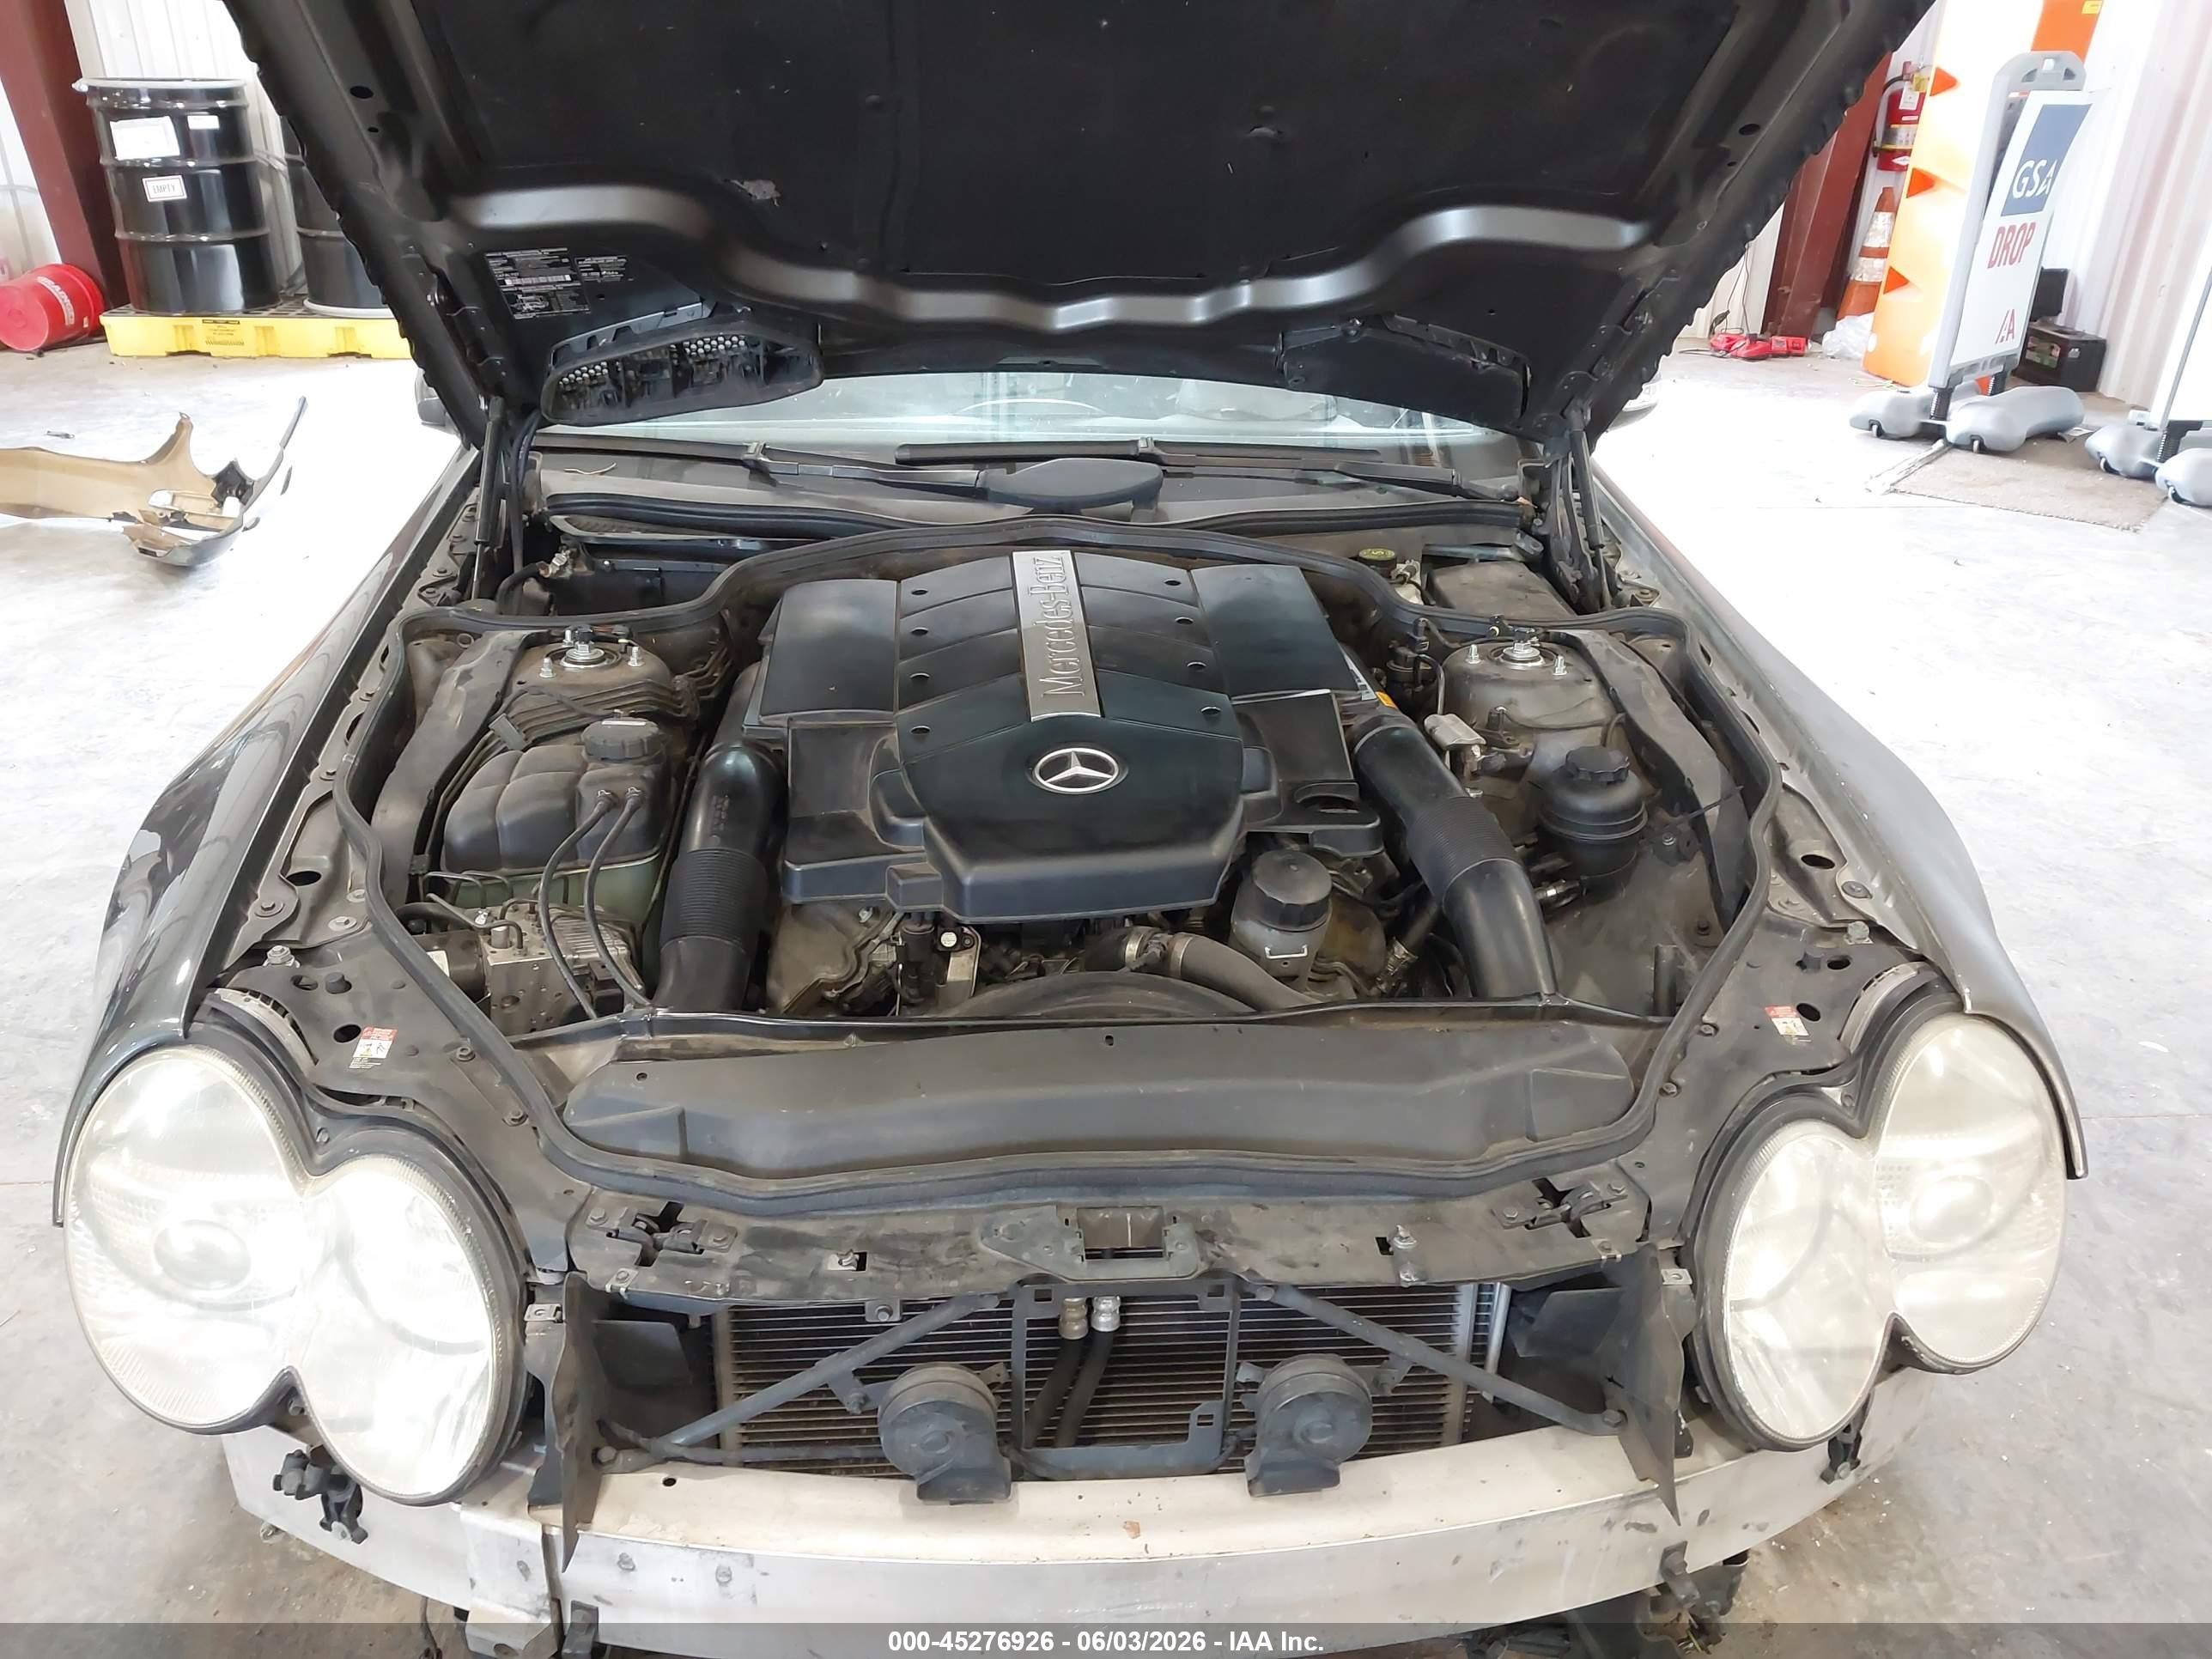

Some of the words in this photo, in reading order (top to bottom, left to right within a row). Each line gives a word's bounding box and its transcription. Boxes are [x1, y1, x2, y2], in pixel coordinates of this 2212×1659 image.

[152, 183, 176, 194] EMPTY
[2012, 159, 2058, 199] GSA
[1987, 222, 2037, 269] DROP
[1028, 556, 1085, 697] Mercedes-Benz
